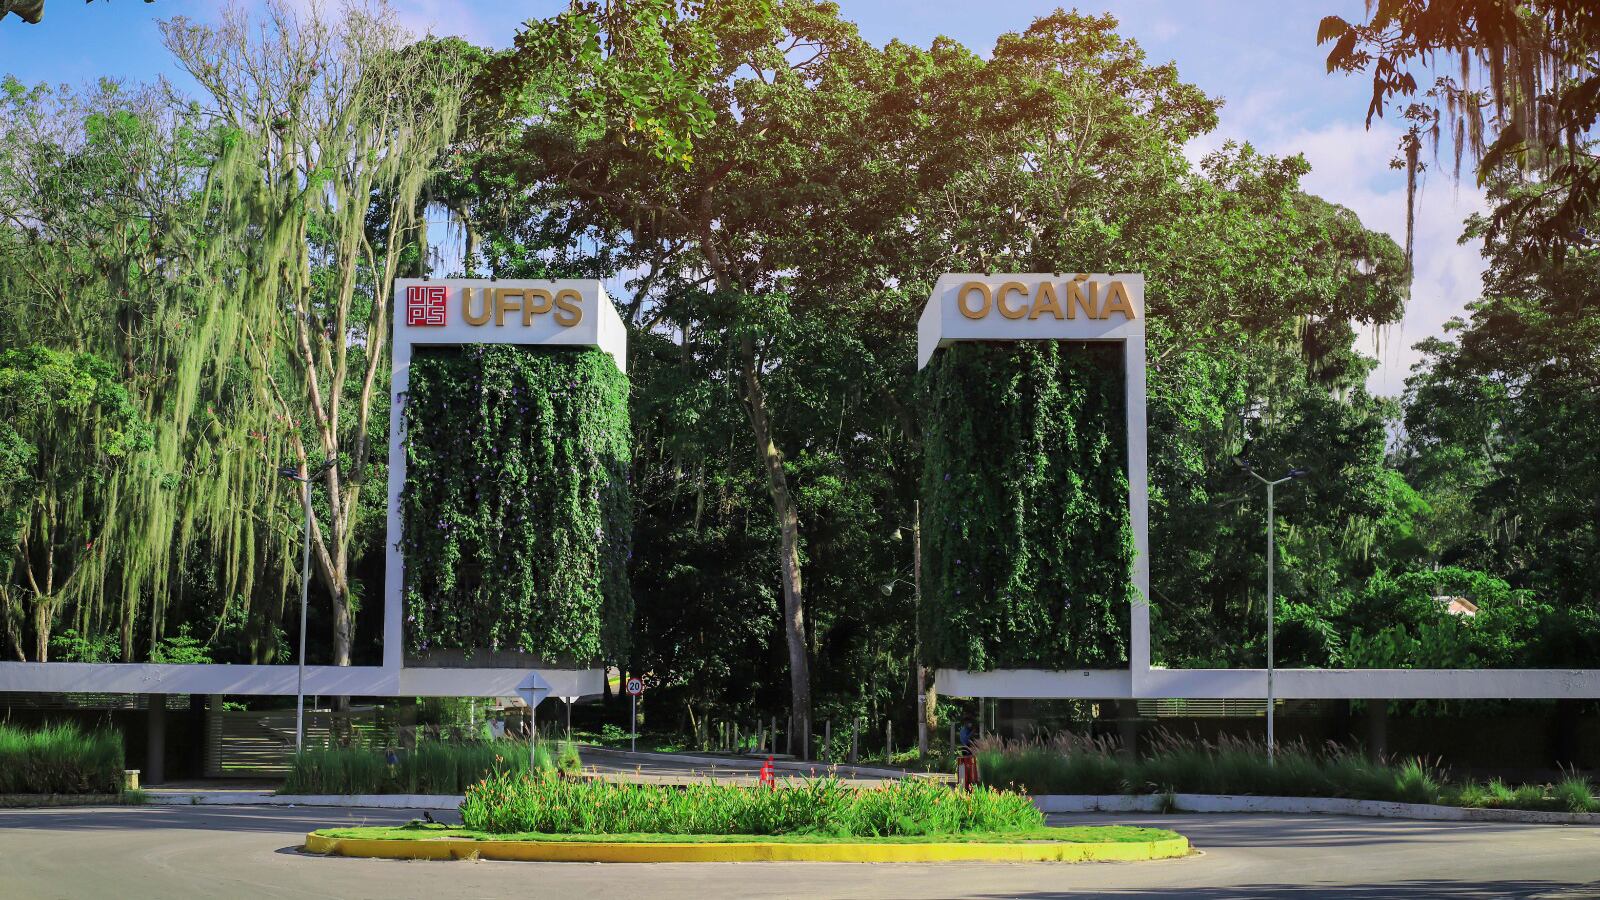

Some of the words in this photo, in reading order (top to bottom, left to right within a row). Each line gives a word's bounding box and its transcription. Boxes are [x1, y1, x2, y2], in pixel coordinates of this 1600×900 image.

[462, 287, 583, 326] UFPS
[957, 273, 1135, 320] OCAÑA
[629, 682, 640, 691] 20
